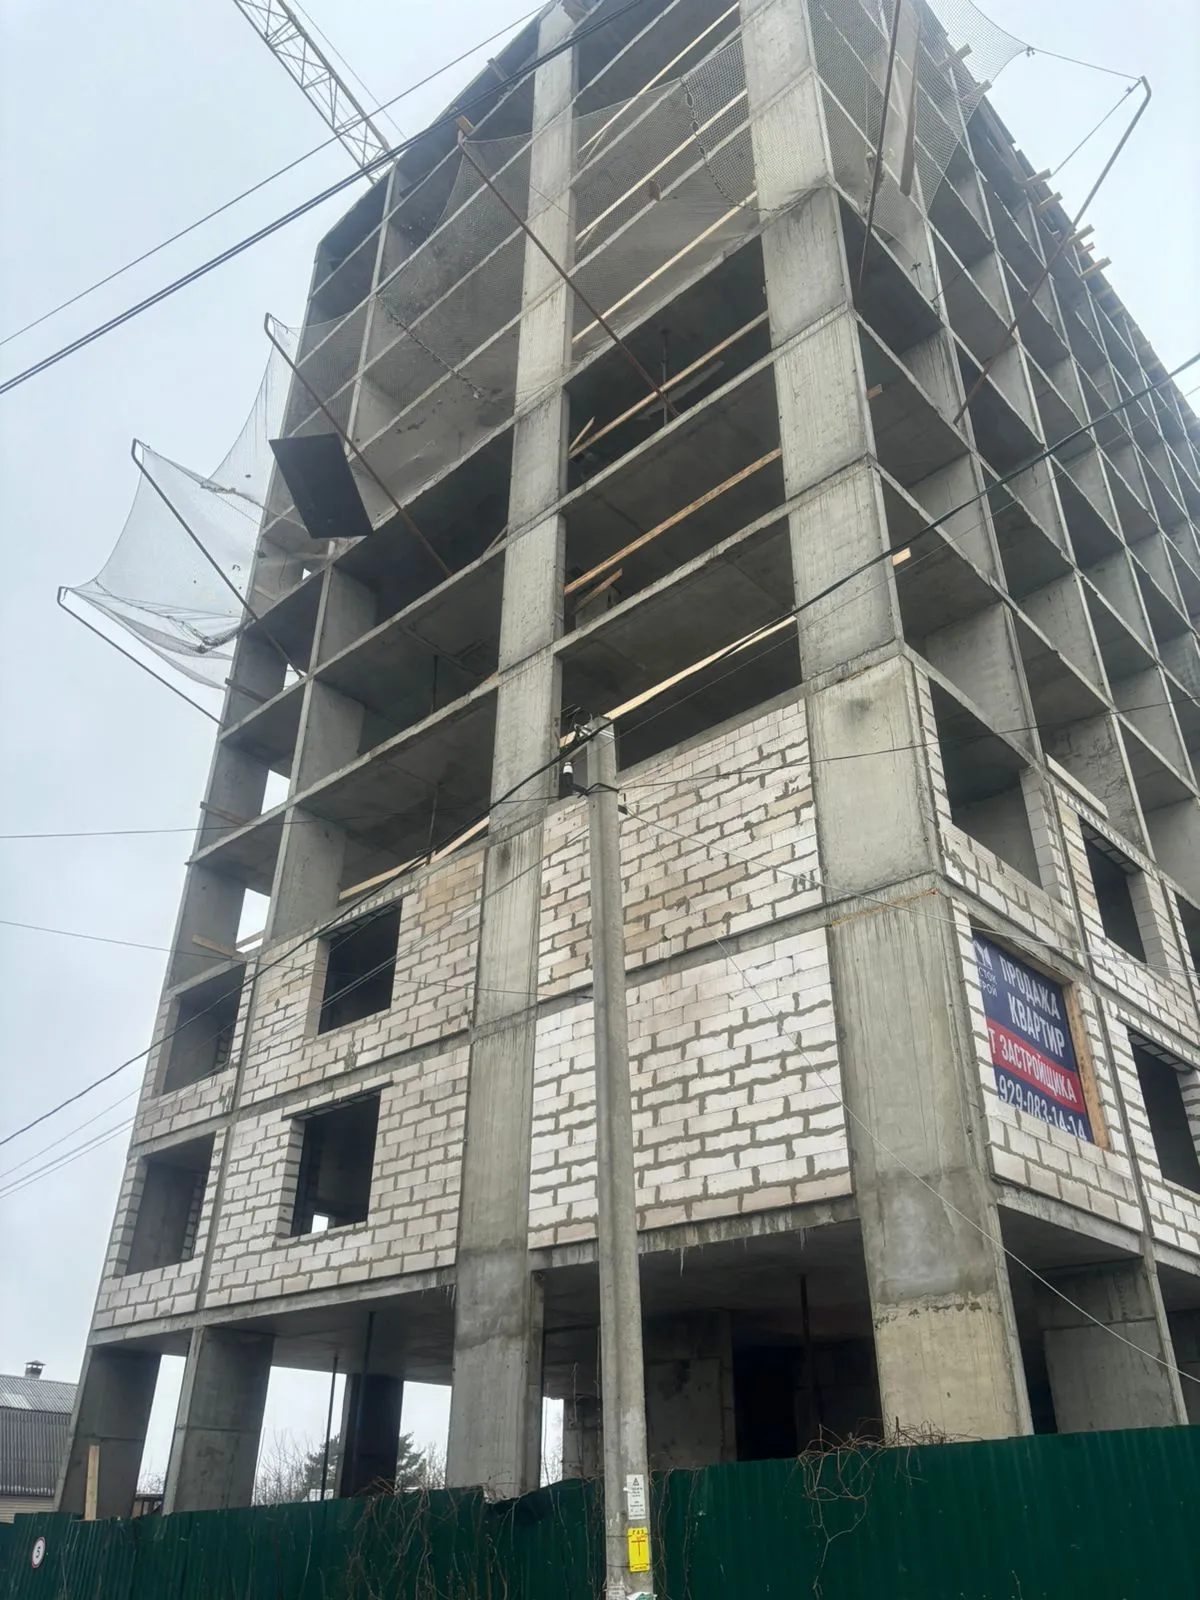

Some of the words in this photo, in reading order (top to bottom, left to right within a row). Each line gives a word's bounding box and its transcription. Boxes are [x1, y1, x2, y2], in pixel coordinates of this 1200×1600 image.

[999, 955, 1061, 1020] ПРОДАЖА
[1008, 992, 1065, 1057] КВАРТИР
[999, 1034, 1077, 1103] ЗАСТРОЙЩИКА
